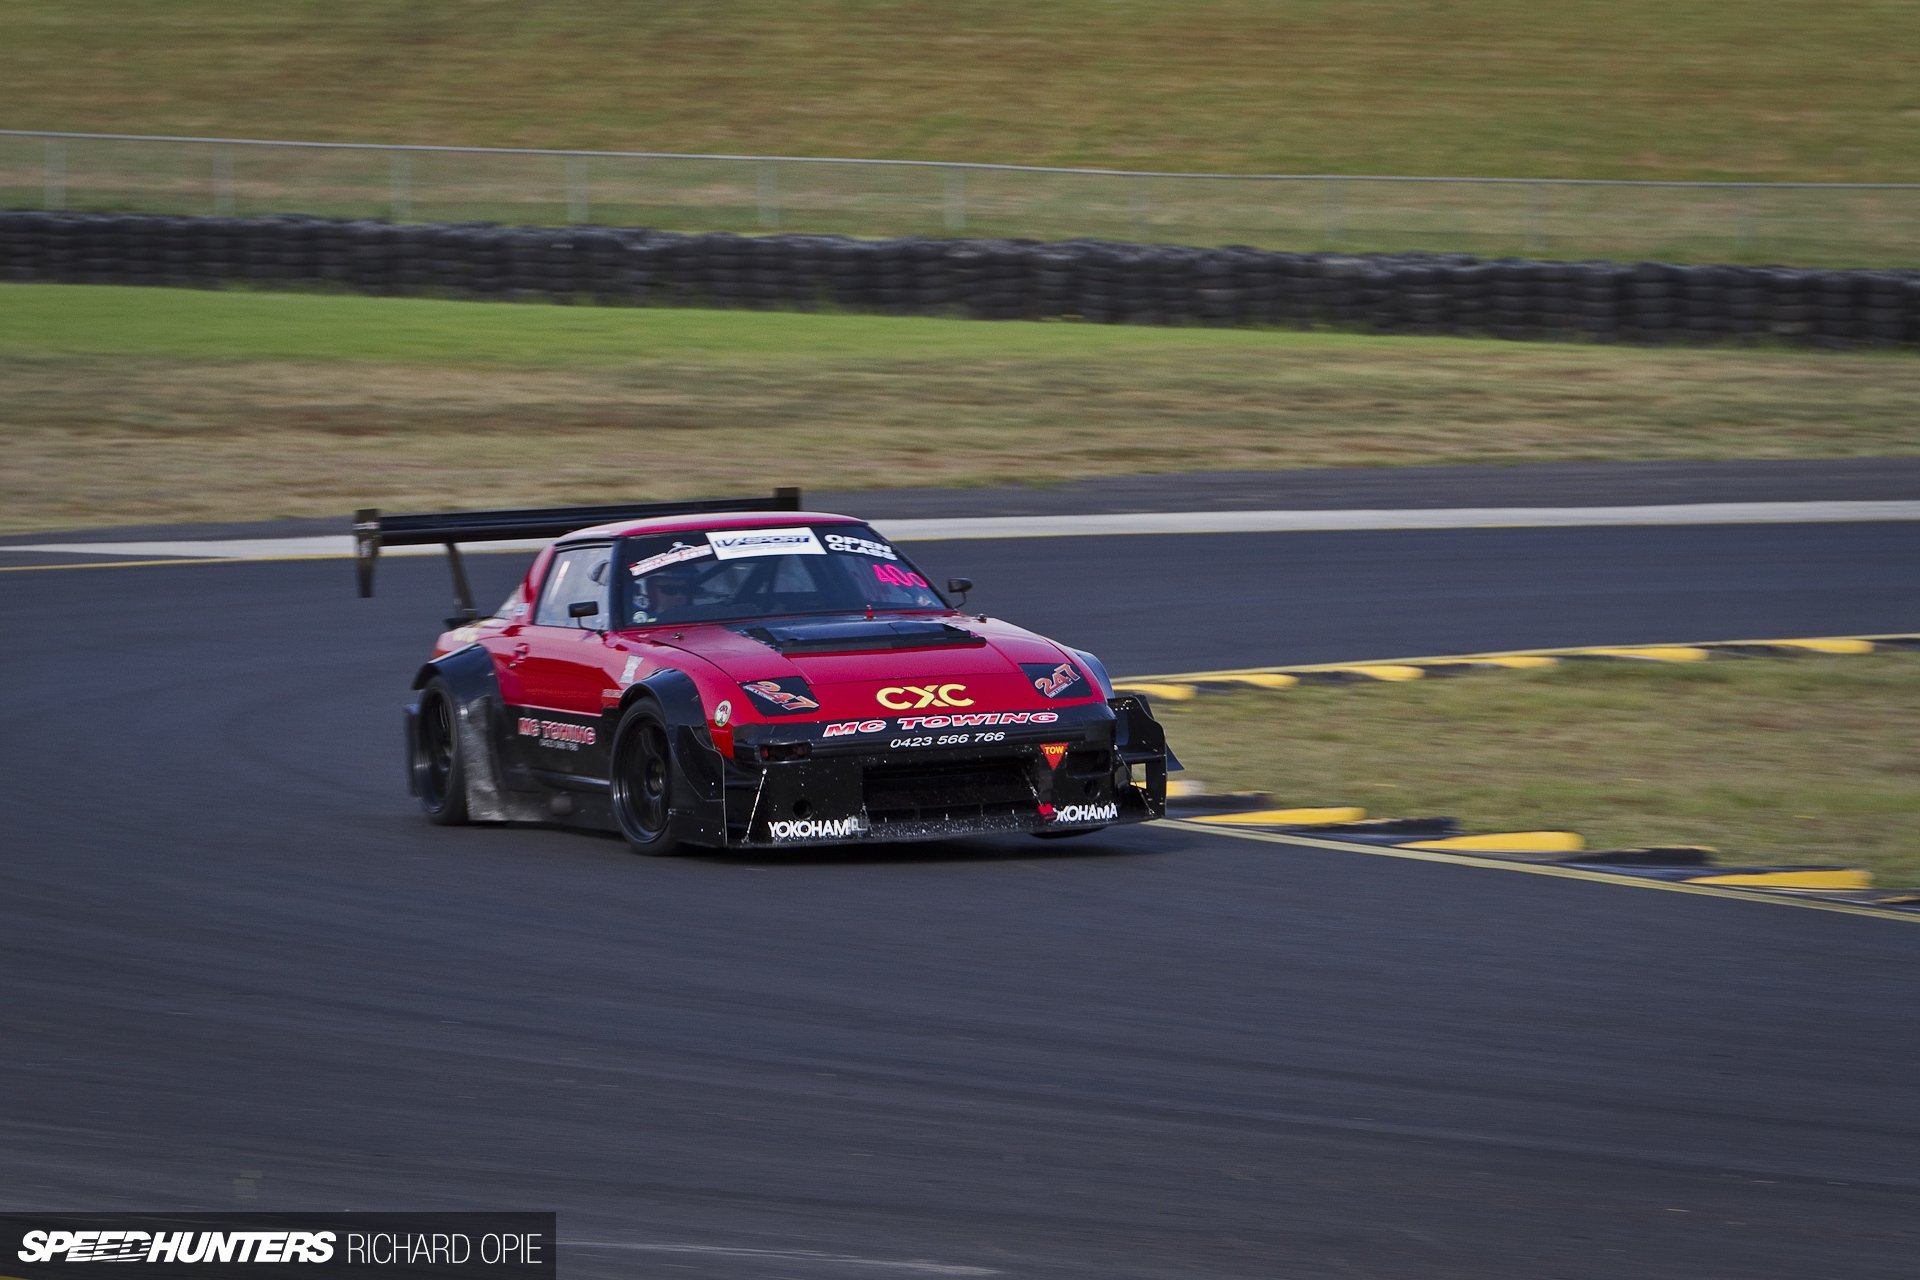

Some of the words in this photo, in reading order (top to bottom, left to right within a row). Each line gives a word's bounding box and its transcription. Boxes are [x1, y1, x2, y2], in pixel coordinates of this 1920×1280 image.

[824, 534, 893, 553] OPEN
[828, 543, 898, 560] CLASS
[1035, 663, 1081, 698] 247
[743, 681, 820, 711] 247
[876, 683, 975, 710] CXC
[541, 720, 597, 746] TOWING
[822, 719, 887, 738] MC
[897, 712, 1059, 731] TOWING
[890, 737, 932, 749] 0423
[936, 734, 969, 745] 566
[974, 731, 1006, 743] 766
[1044, 746, 1065, 755] TOW
[1053, 803, 1118, 822] KOHAMA
[767, 819, 853, 838] YOKOHAM
